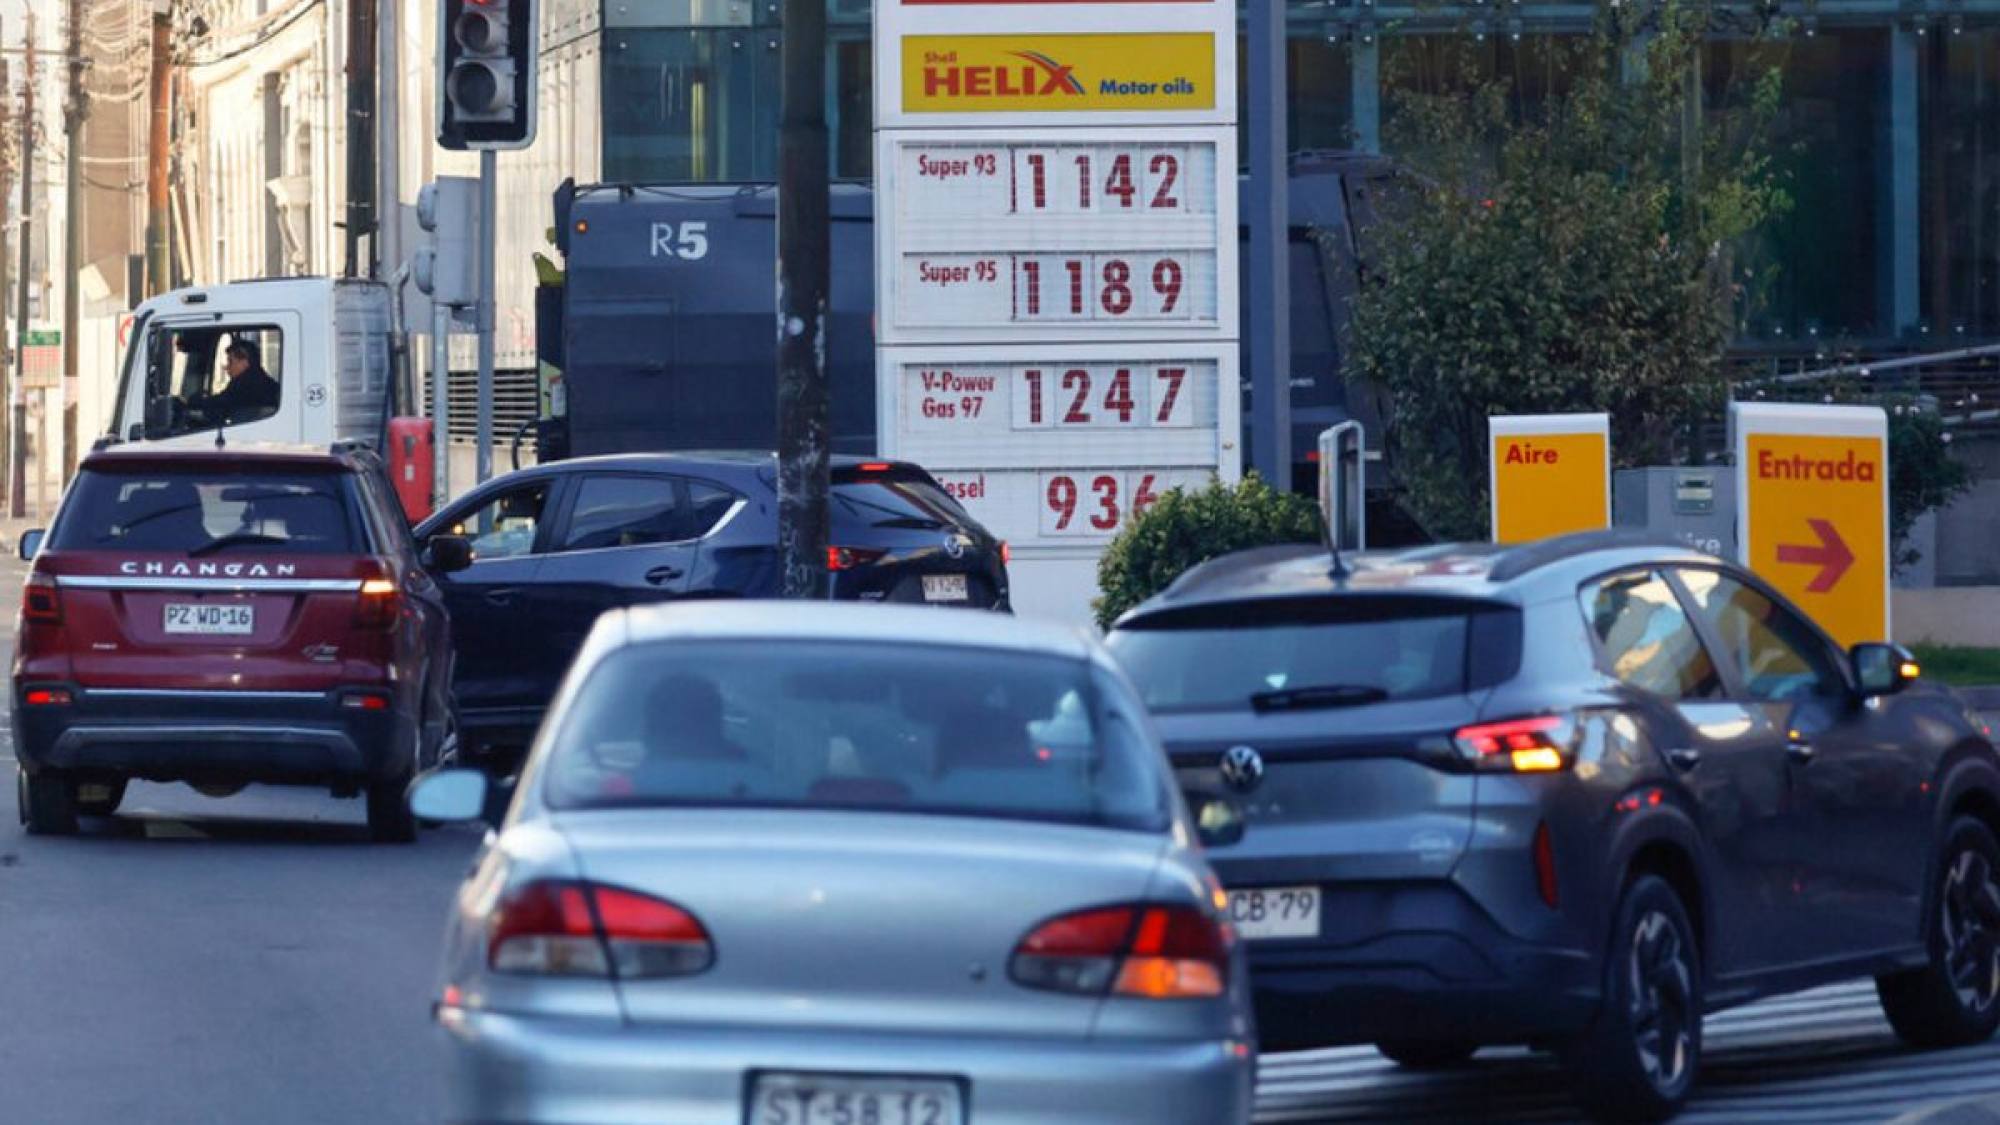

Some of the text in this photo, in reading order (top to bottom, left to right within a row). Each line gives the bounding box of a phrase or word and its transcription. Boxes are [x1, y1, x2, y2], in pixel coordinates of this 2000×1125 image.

[924, 51, 957, 63] Shell
[923, 65, 1082, 97] HELIX
[1099, 76, 1195, 95] Motor oils
[919, 154, 1180, 209] Super 93 1142
[919, 258, 1183, 315] Super 95 1189
[920, 371, 996, 393] V-Power
[921, 396, 984, 419] Gas 97
[1024, 368, 1187, 424] 1247
[1504, 443, 1560, 465] Aire
[1757, 449, 1875, 482] Entrada
[938, 473, 985, 499] esel
[120, 561, 296, 576] CHANGAN
